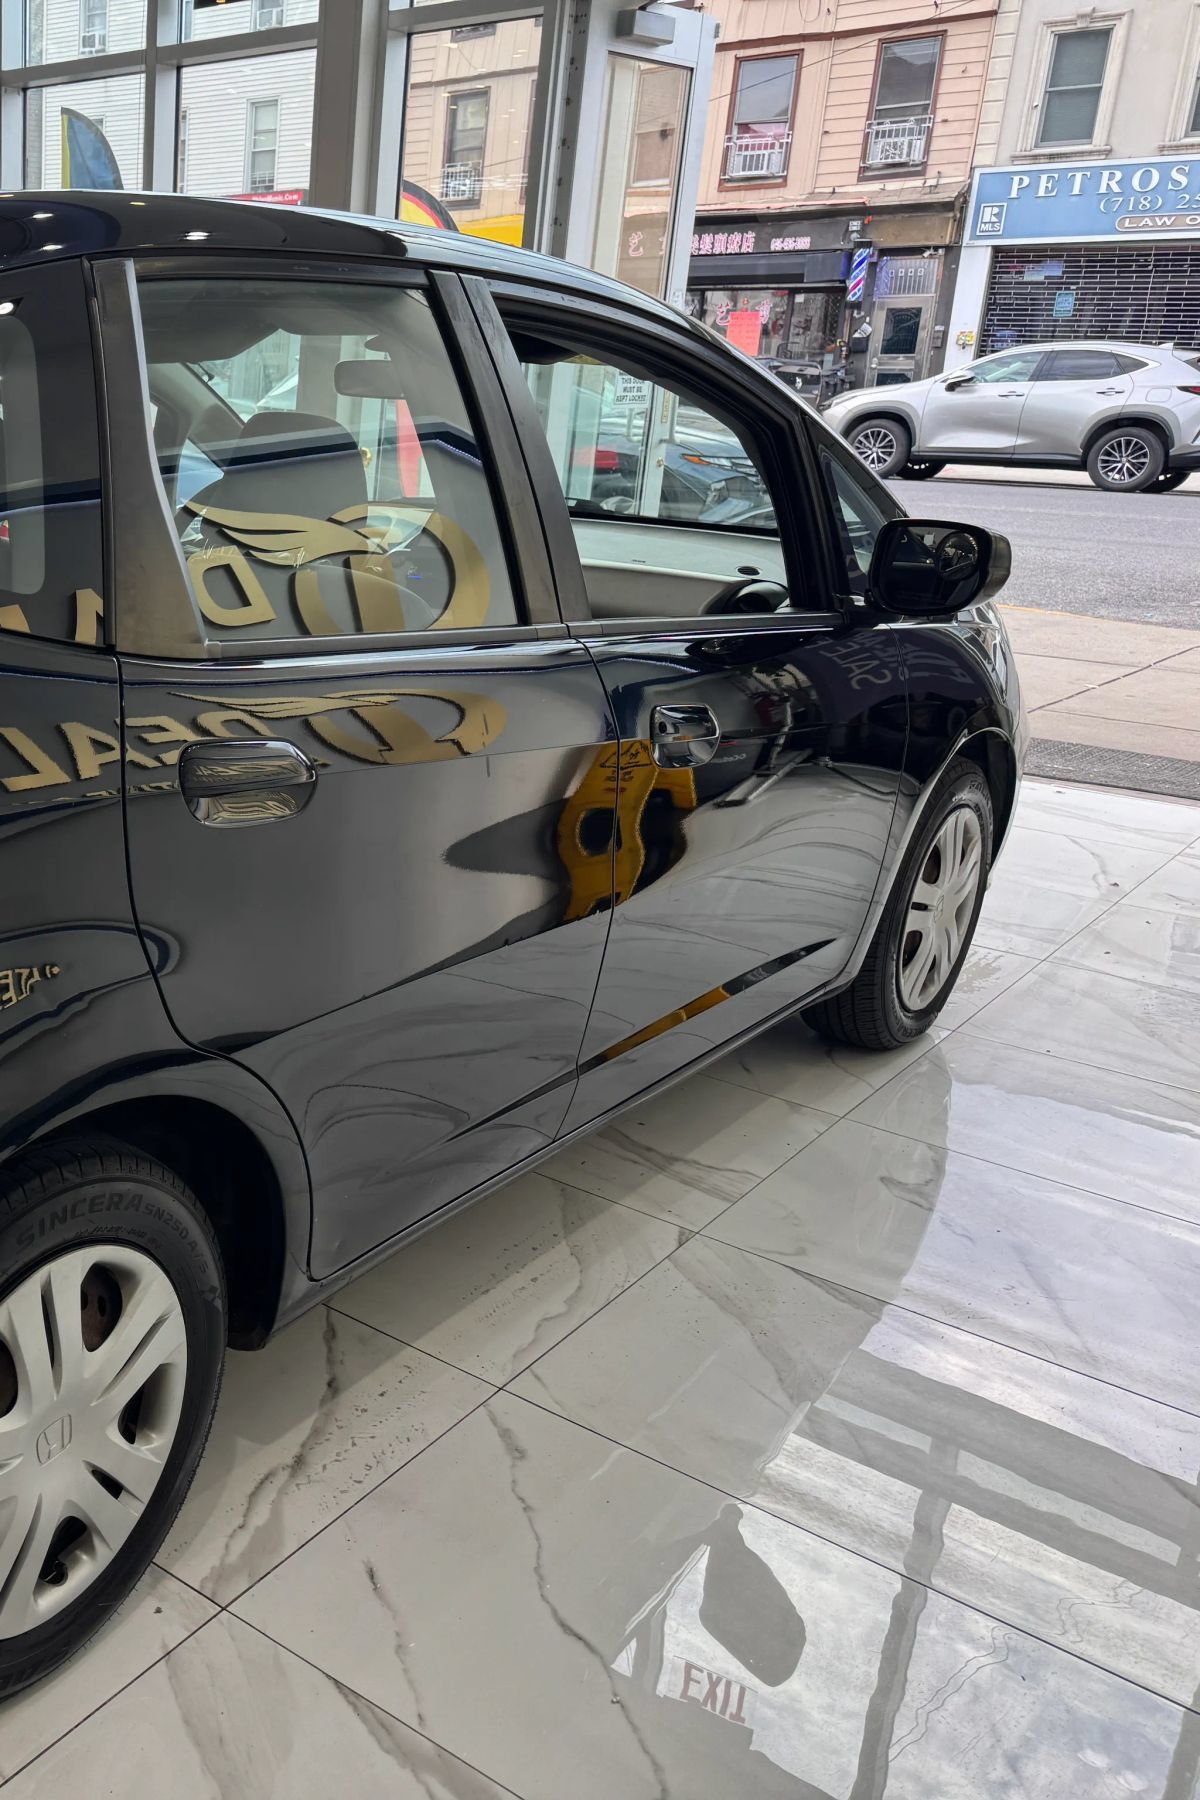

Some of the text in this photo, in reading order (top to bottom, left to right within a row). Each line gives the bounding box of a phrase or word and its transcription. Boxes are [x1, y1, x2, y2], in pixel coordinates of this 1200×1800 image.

[1100, 195, 1163, 213] (718)
[980, 223, 1001, 232] MLS
[1123, 215, 1176, 228] LAW
[16, 1192, 143, 1250] SINCERA
